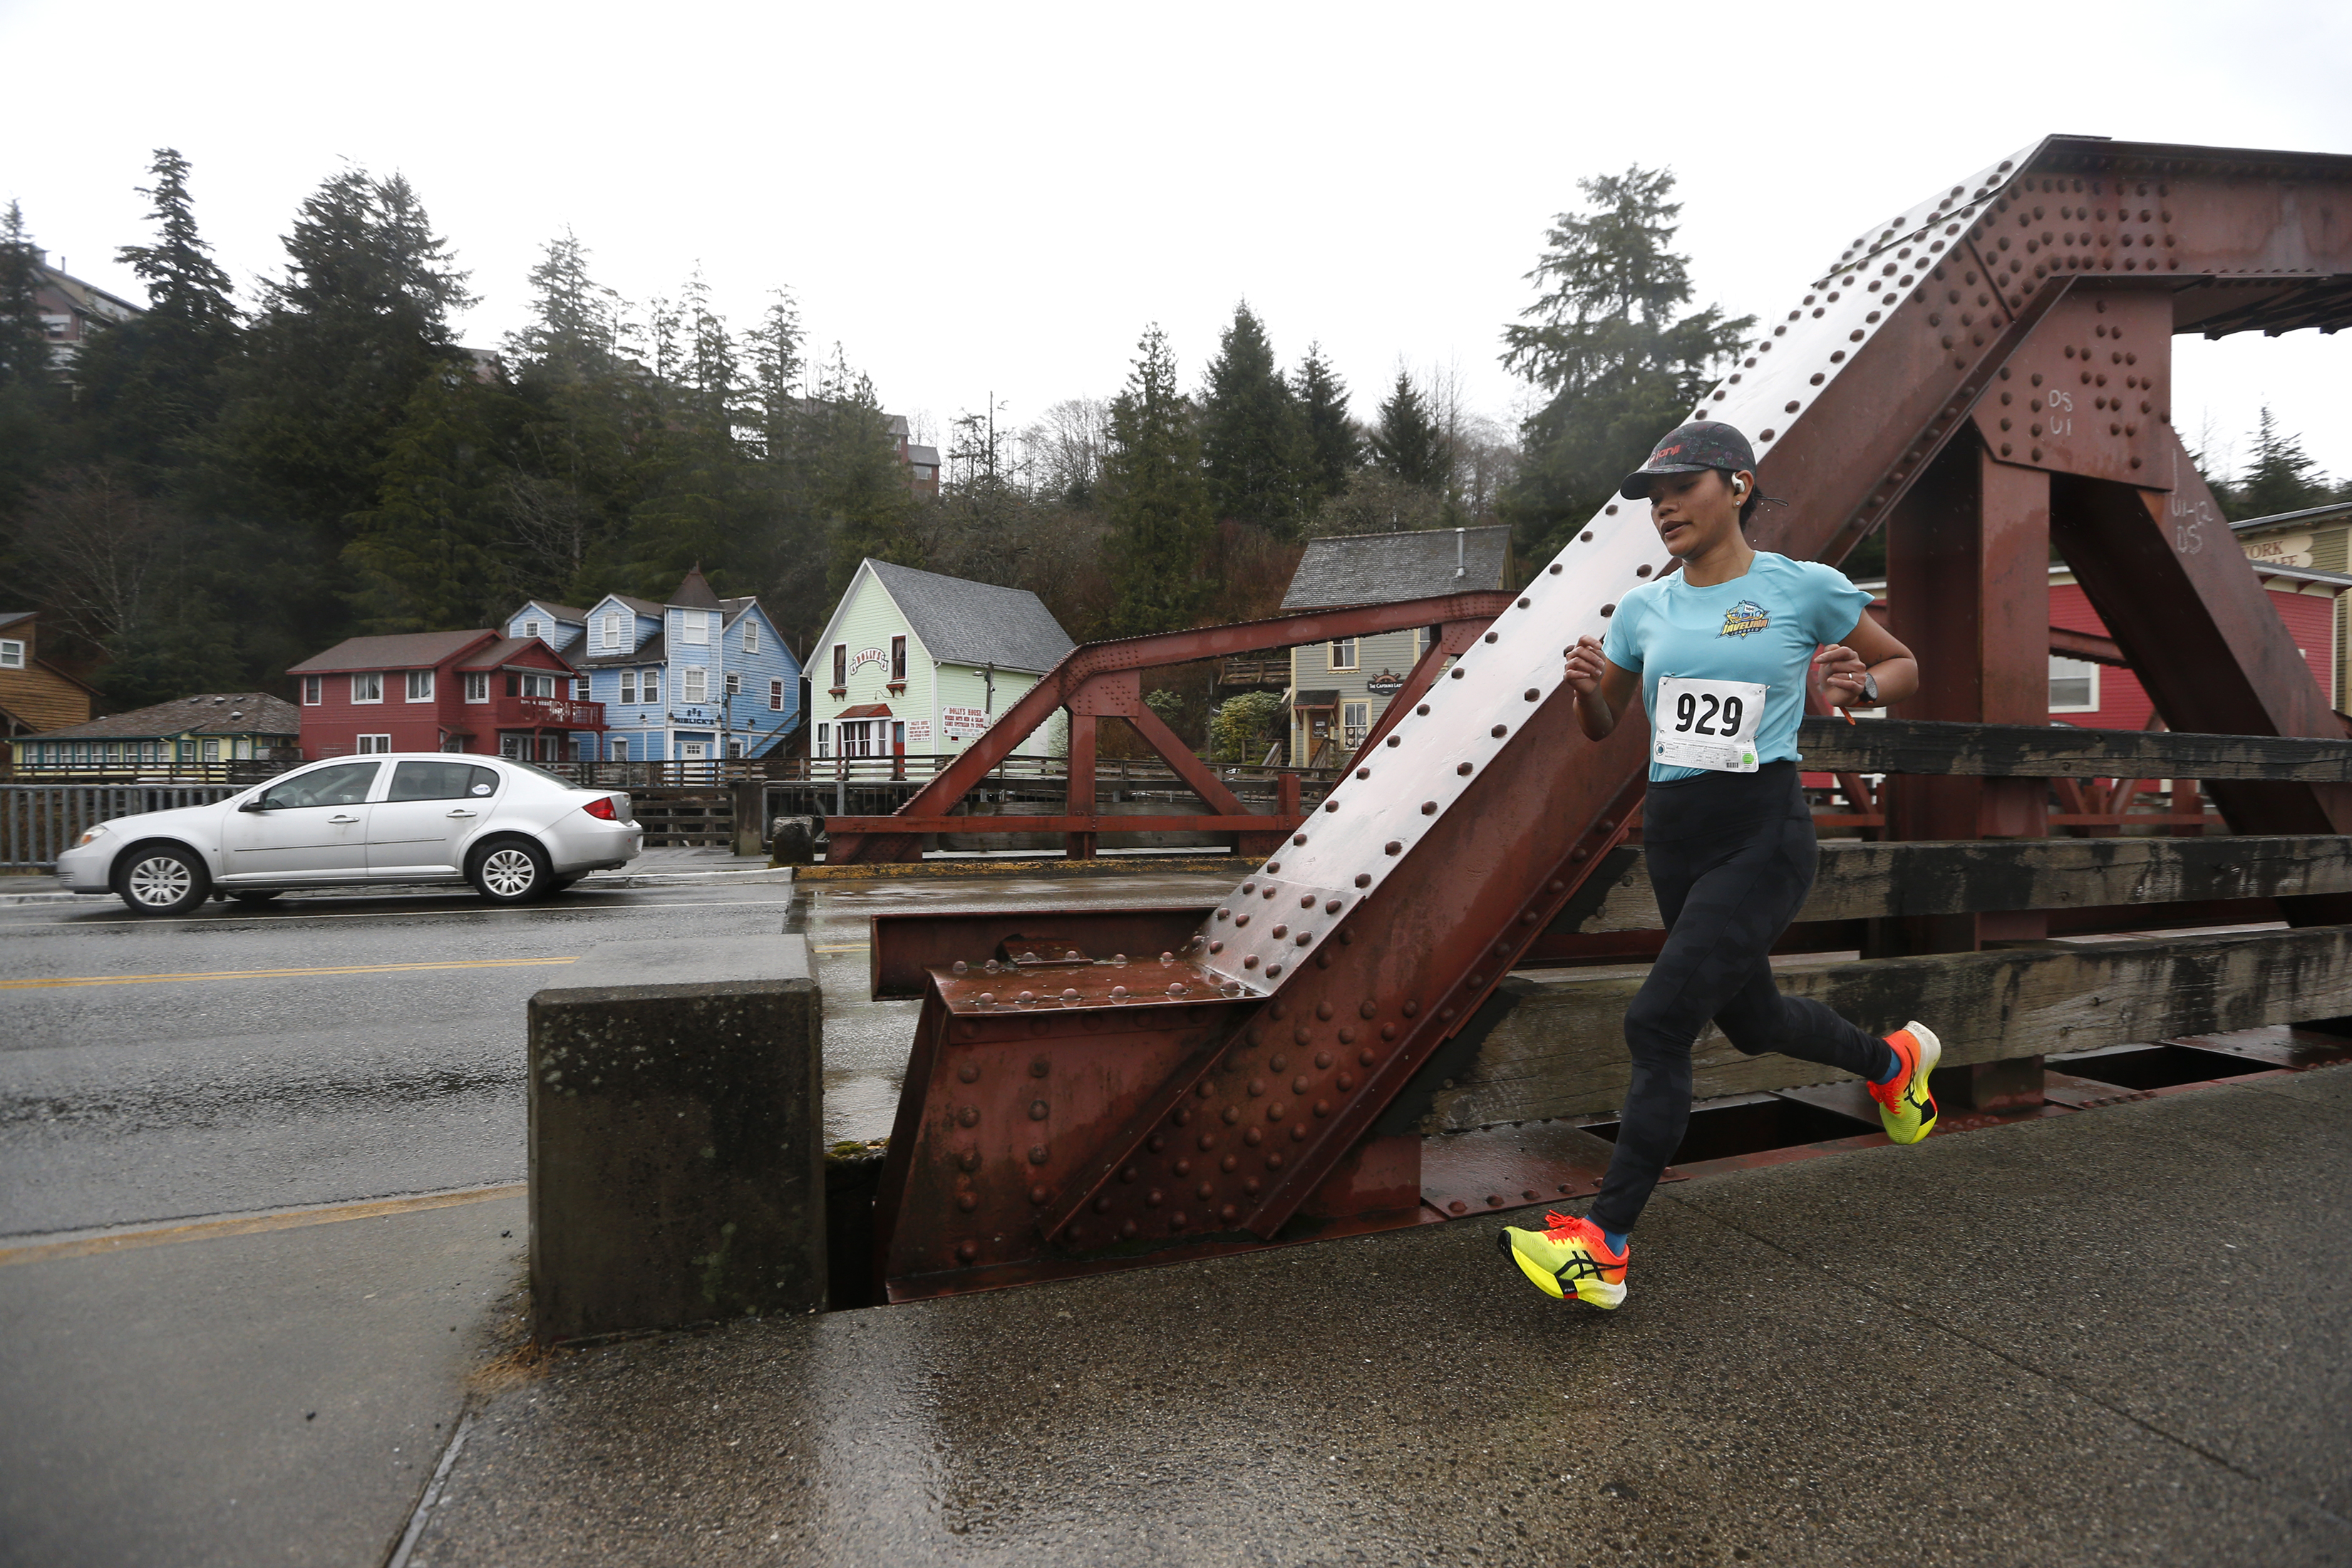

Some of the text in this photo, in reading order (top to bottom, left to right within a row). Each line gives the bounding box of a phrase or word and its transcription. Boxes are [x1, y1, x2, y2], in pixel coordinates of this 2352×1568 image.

[1721, 619, 1768, 636] JAVELINA
[1731, 627, 1759, 636] JUNDRED
[856, 650, 882, 664] DOLLY'S
[949, 707, 981, 717] DOLLY'S HOUSE
[1675, 693, 1743, 737] 929
